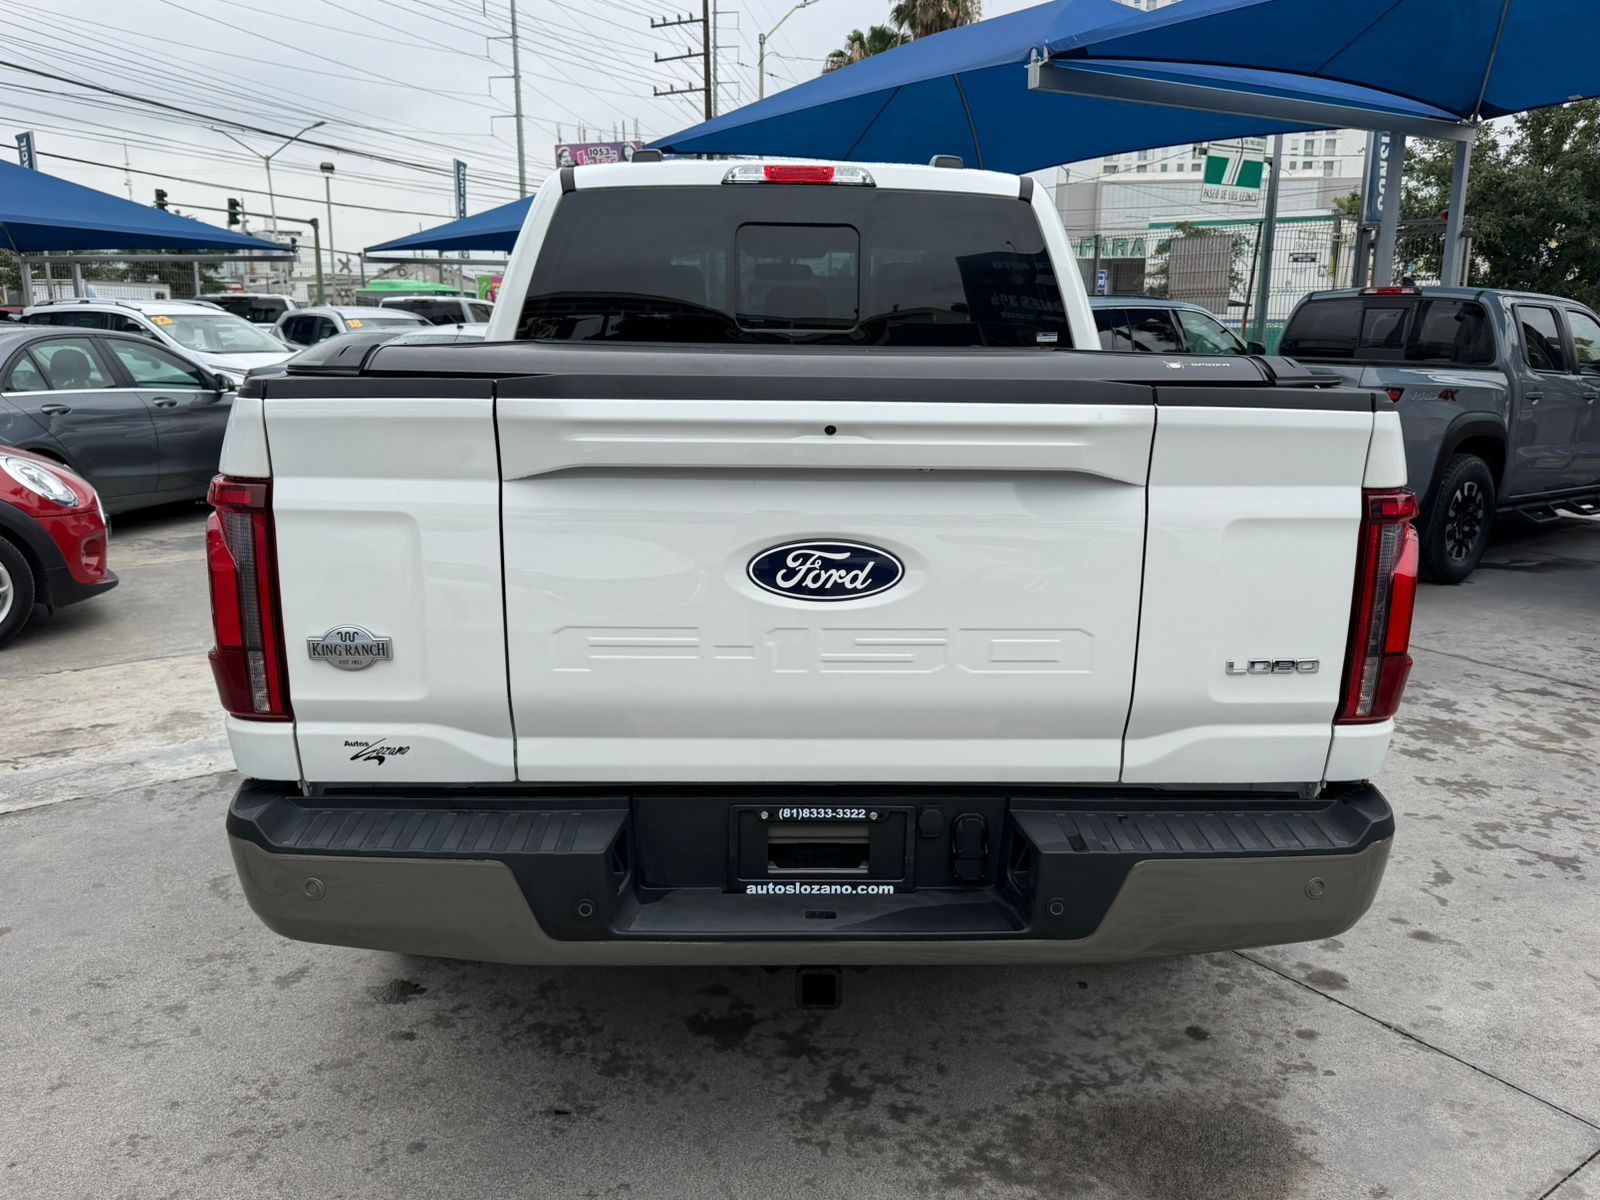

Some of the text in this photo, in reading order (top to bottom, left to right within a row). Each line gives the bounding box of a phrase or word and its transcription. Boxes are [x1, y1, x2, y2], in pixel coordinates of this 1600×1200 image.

[1377, 131, 1391, 211] CONSI
[1202, 188, 1258, 202] PASEO DE LOS LEONES
[776, 551, 875, 589] Ford
[312, 643, 386, 656] KING RANCH
[1225, 658, 1320, 676] LOBO
[343, 739, 370, 748] Autos
[778, 807, 867, 821] (81)8333-3322
[745, 882, 895, 895] autoslozano.com
